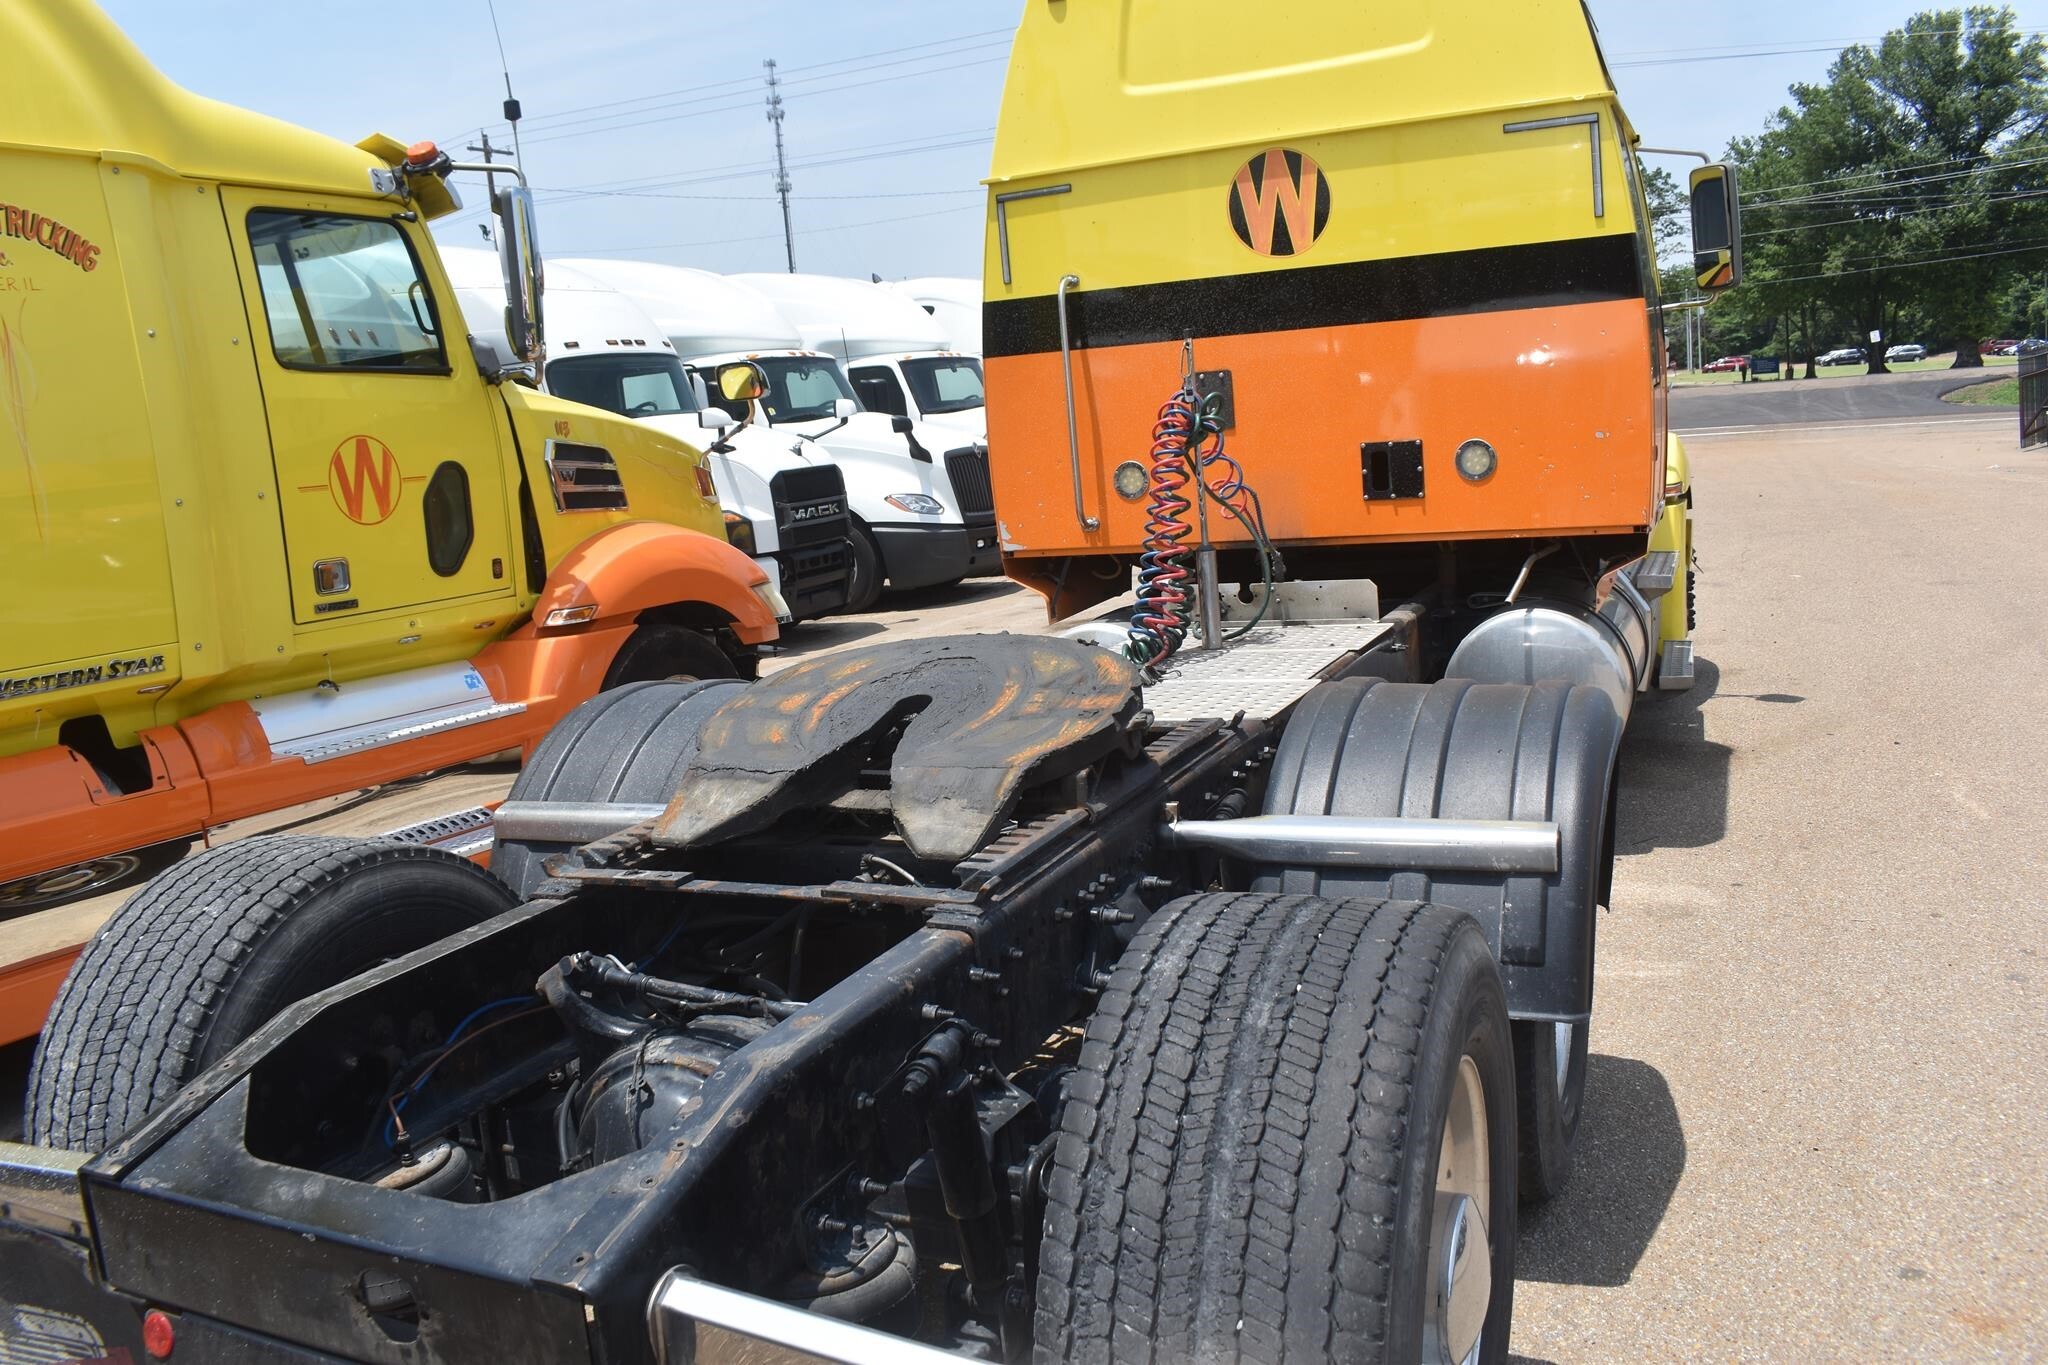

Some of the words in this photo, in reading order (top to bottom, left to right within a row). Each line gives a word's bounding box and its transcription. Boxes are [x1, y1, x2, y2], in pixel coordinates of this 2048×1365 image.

[1235, 148, 1318, 256] W
[333, 437, 393, 521] W
[790, 503, 840, 520] MACK
